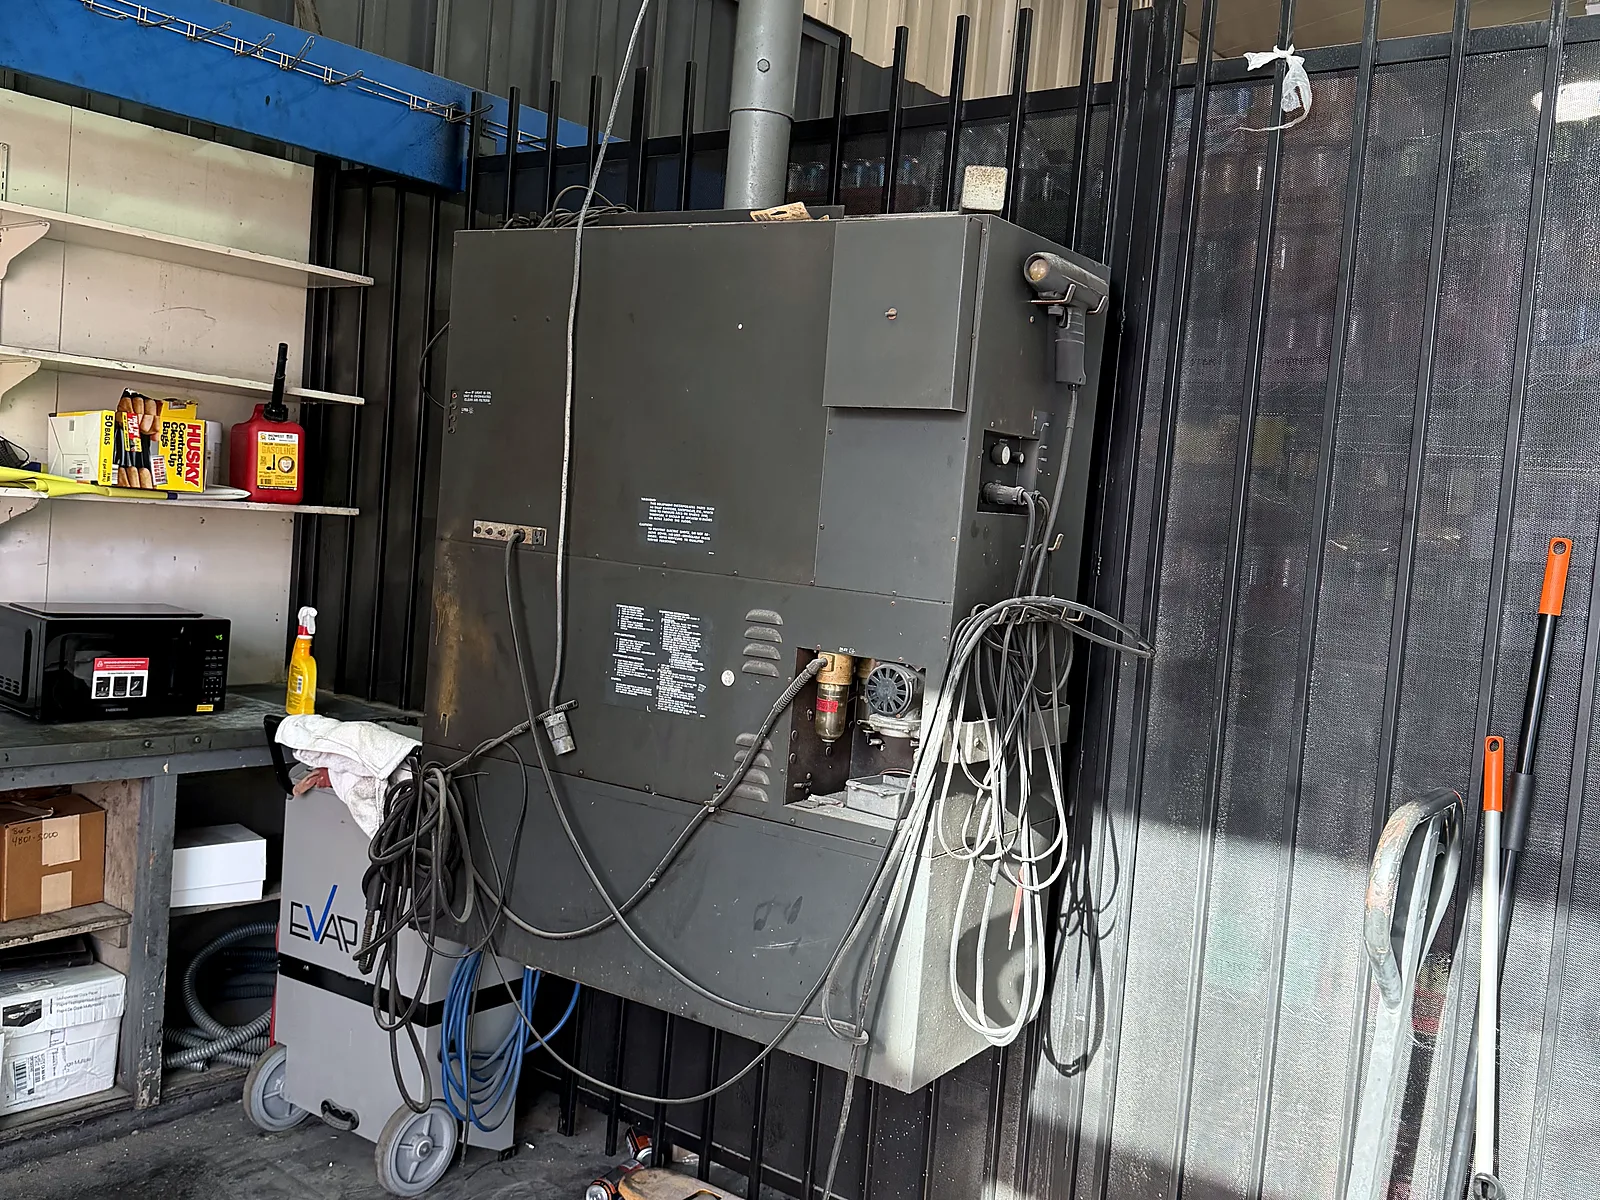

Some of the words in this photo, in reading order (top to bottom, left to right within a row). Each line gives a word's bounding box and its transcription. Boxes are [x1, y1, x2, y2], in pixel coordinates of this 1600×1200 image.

[105, 415, 113, 427] 50
[161, 421, 170, 447] Bags
[169, 422, 178, 467] Clean-Up
[176, 422, 186, 477] Contractor
[185, 424, 201, 486] HUSKY
[262, 446, 296, 456] GASOLINE
[289, 884, 358, 954] EVAP
